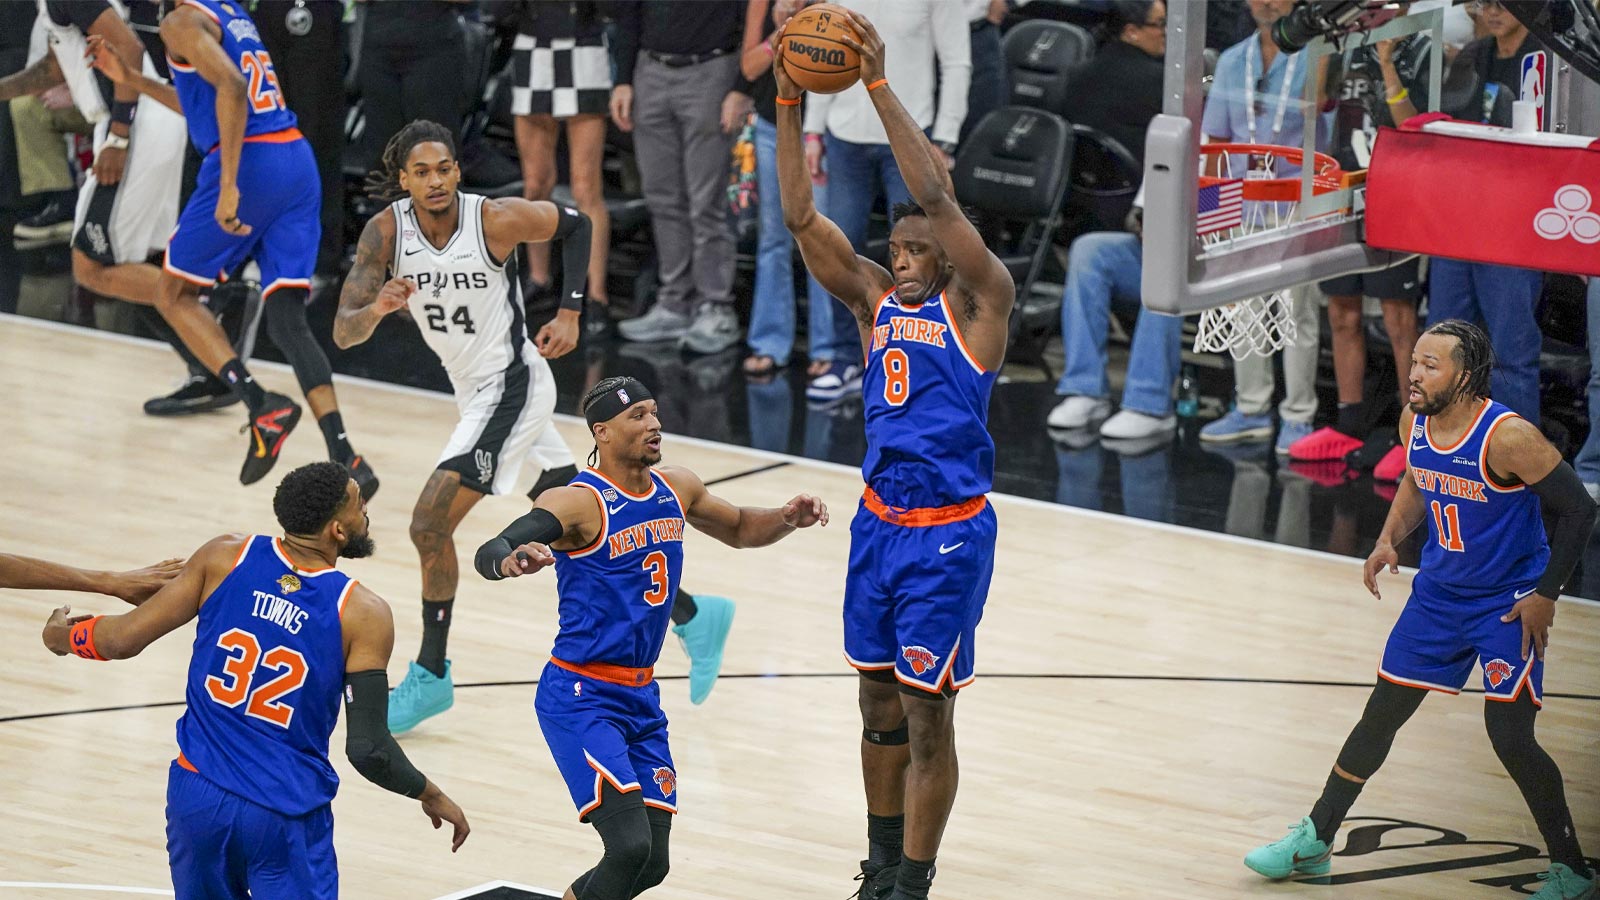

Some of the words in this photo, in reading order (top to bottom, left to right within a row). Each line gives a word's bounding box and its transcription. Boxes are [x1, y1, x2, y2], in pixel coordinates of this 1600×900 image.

[789, 40, 846, 66] Wilson
[241, 50, 286, 114] 25
[424, 304, 476, 334] 24
[872, 323, 891, 352] NE
[890, 316, 948, 349] YORK
[882, 348, 910, 406] 8
[1436, 472, 1489, 503] YORK
[608, 523, 648, 560] NEW
[646, 517, 684, 544] YORK
[1431, 500, 1465, 552] 11
[642, 550, 669, 607] 3
[251, 590, 309, 635] TOWNS
[204, 627, 310, 730] 32
